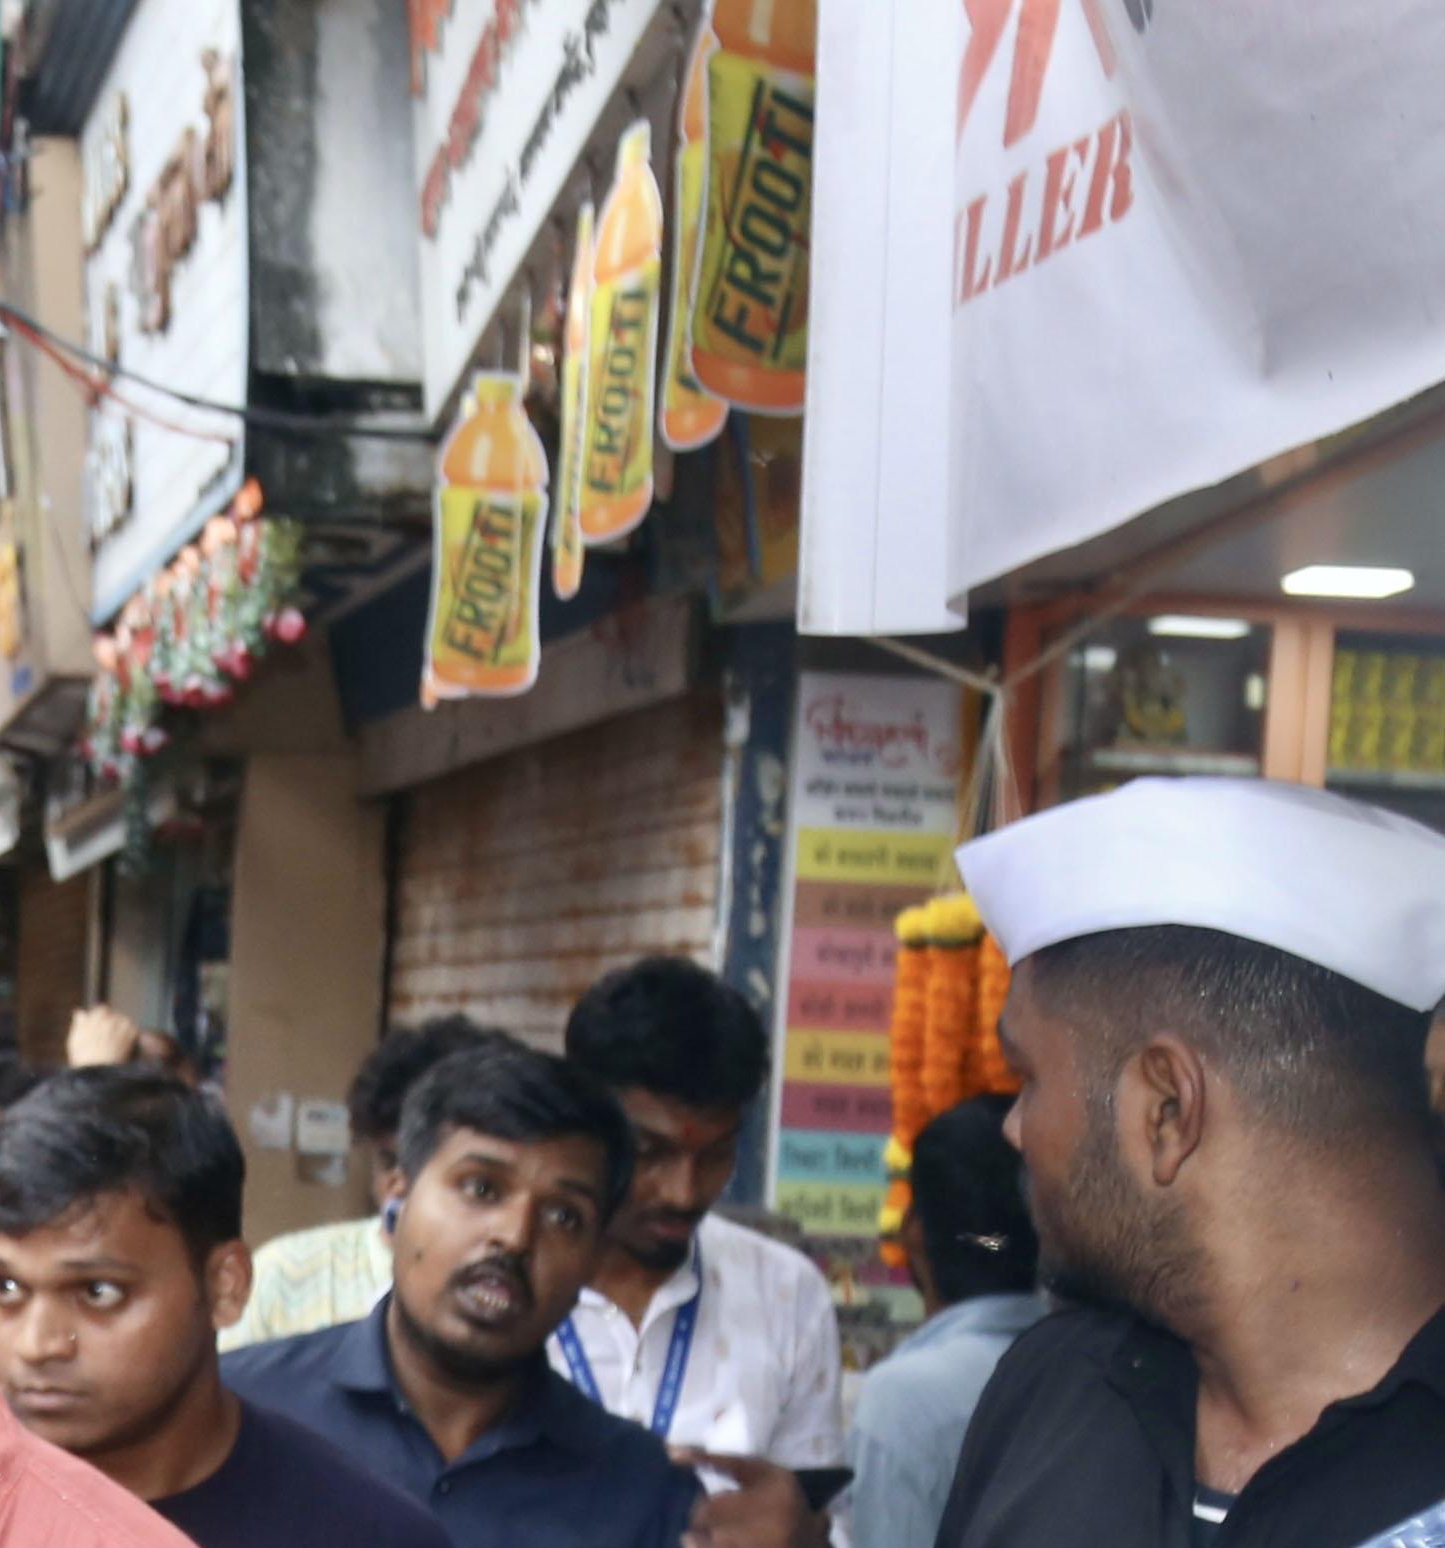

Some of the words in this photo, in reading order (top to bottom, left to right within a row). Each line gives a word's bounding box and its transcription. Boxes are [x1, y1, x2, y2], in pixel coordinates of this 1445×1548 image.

[952, 108, 1134, 310] LLER
[589, 286, 649, 493] FROOTI
[447, 503, 518, 661] FROOTI
